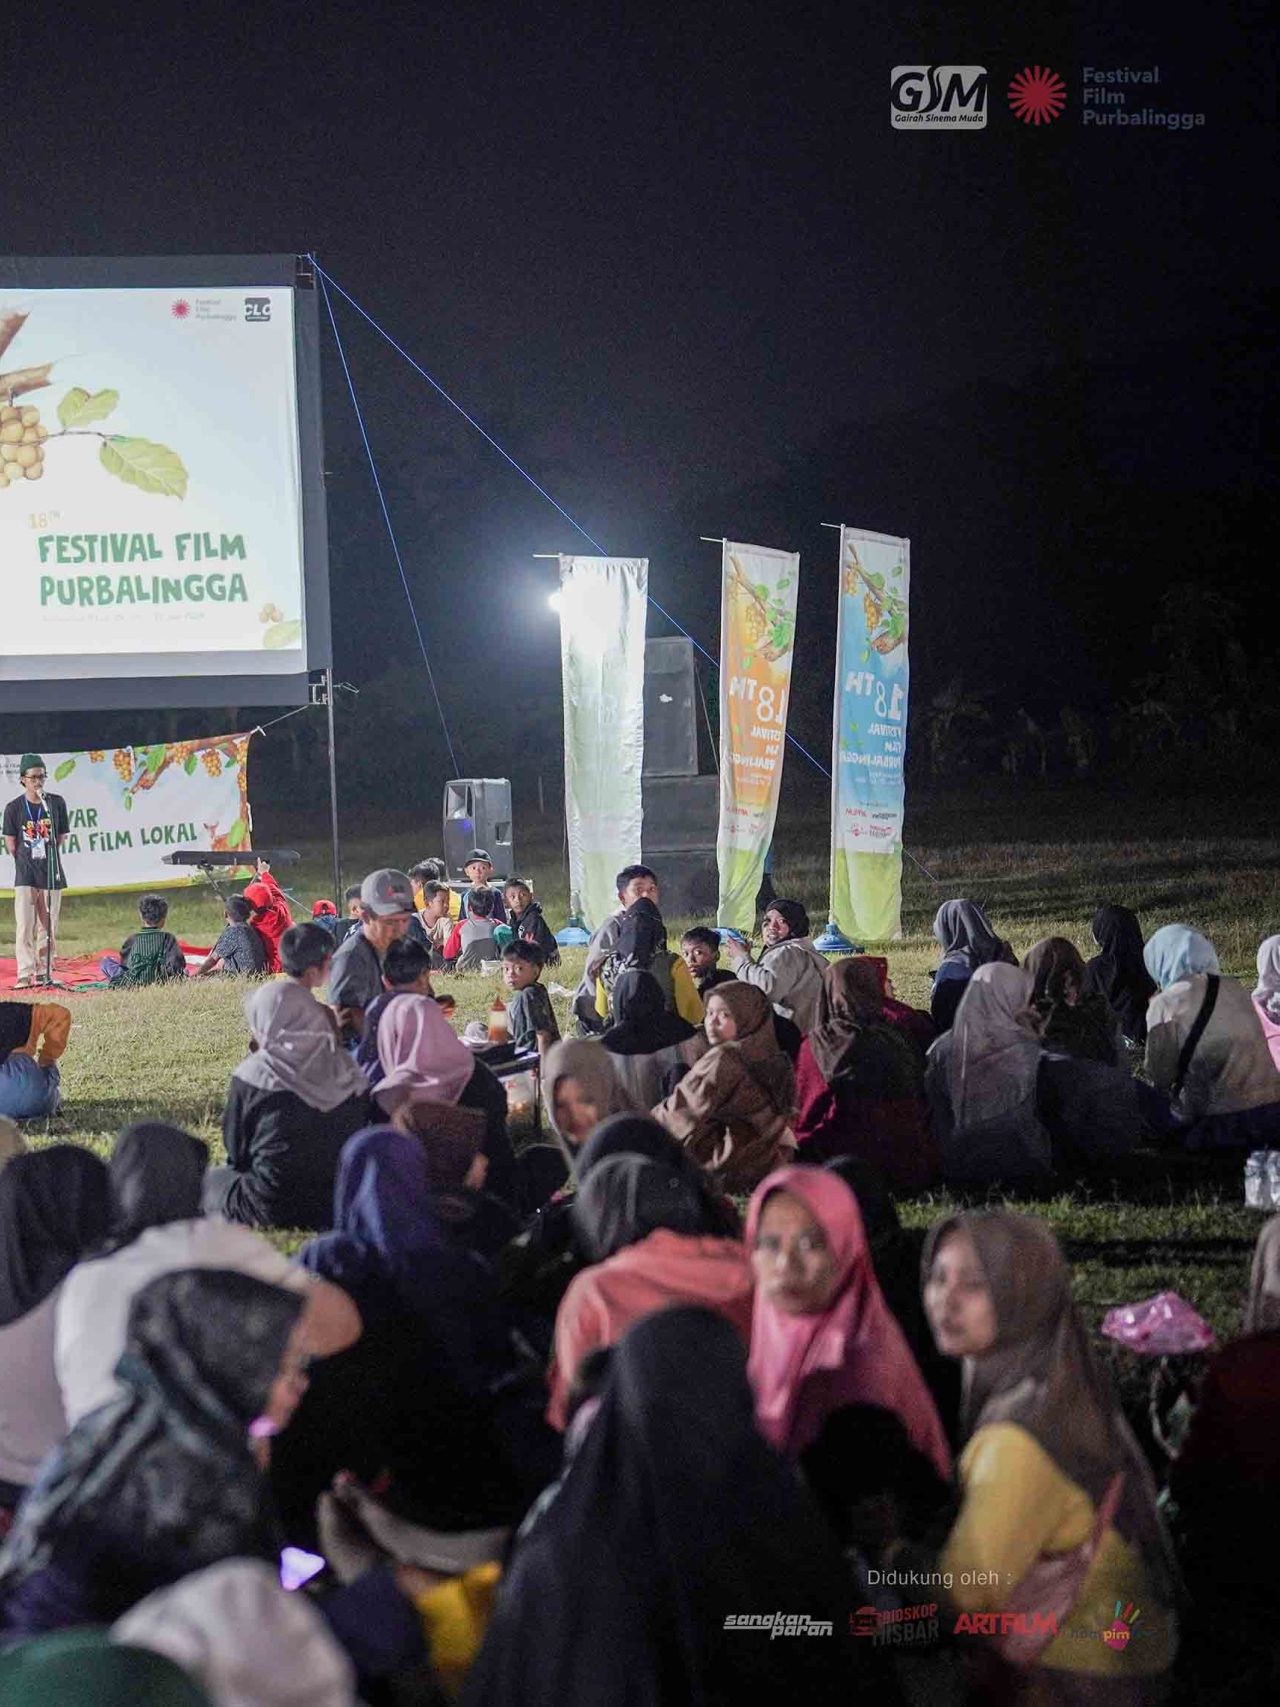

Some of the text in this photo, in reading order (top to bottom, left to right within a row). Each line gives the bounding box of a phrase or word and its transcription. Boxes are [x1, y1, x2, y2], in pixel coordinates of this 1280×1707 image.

[38, 532, 247, 564] FESTIVAL FILM
[40, 573, 249, 607] PURBALINGGA
[140, 822, 197, 844] LOKAL
